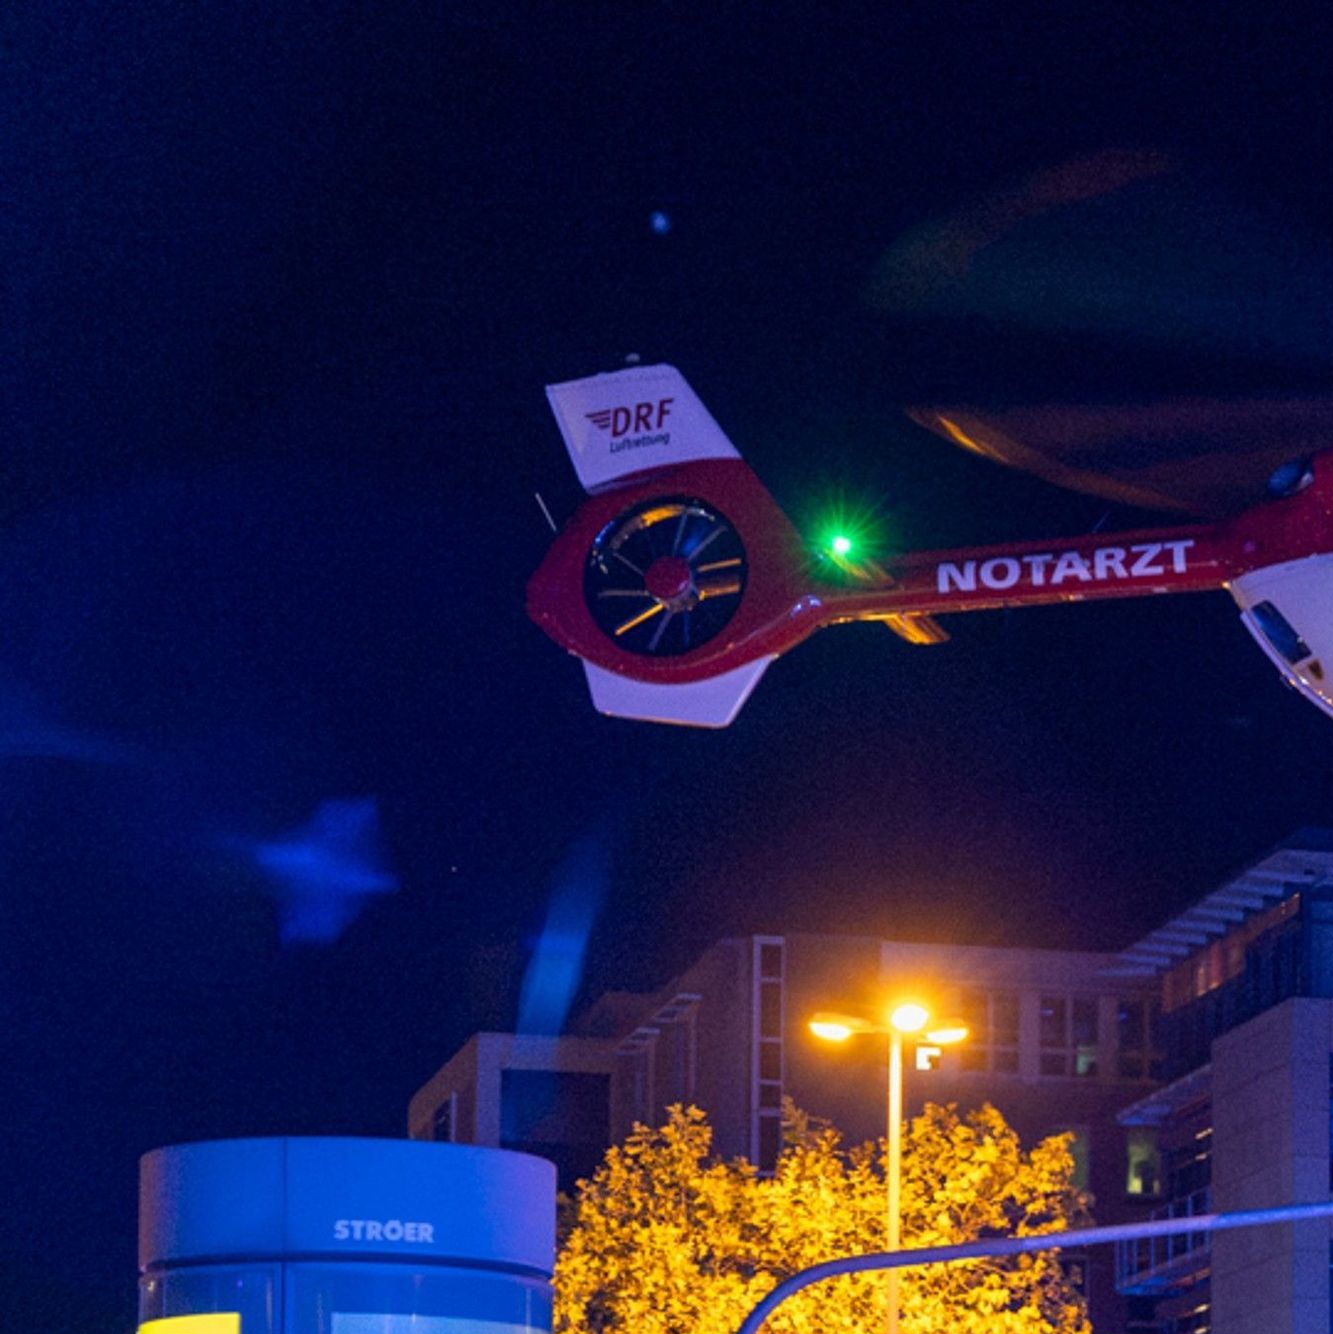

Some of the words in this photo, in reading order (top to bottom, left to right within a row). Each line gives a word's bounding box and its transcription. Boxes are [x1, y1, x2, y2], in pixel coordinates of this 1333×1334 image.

[611, 397, 675, 438] DRF
[609, 432, 671, 454] Luftrettung
[936, 539, 1195, 594] NOTARZT
